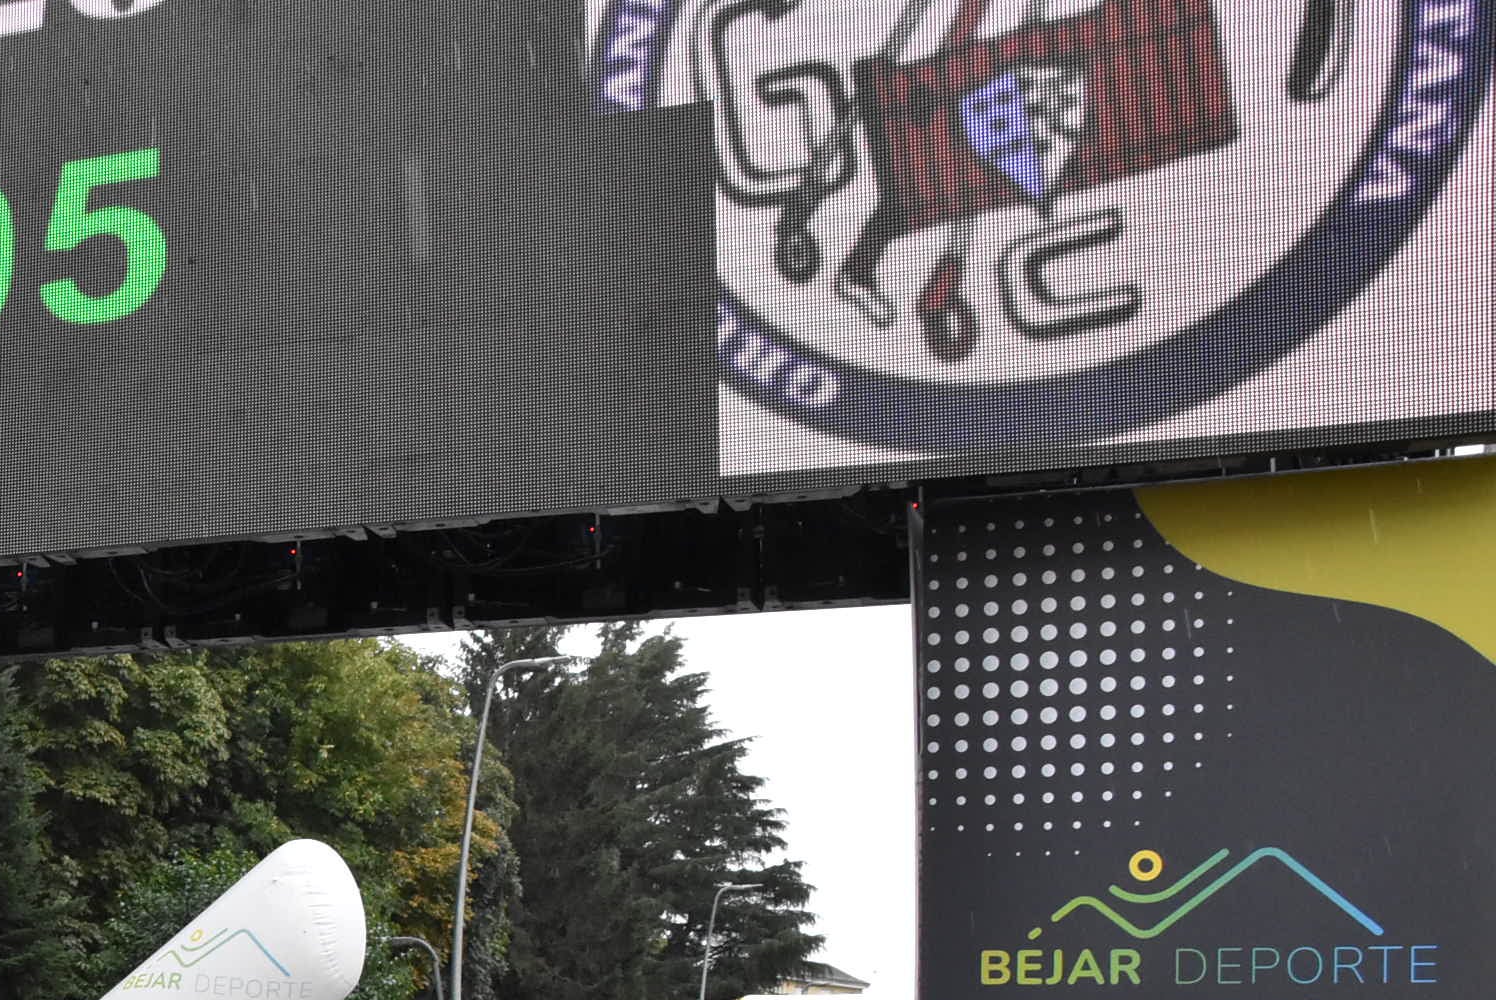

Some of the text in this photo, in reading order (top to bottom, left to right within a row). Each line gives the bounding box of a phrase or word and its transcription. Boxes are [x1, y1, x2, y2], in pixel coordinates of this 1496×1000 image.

[981, 930, 1438, 986] BÉJAR DEPORTE
[194, 974, 313, 999] DEPORTE
